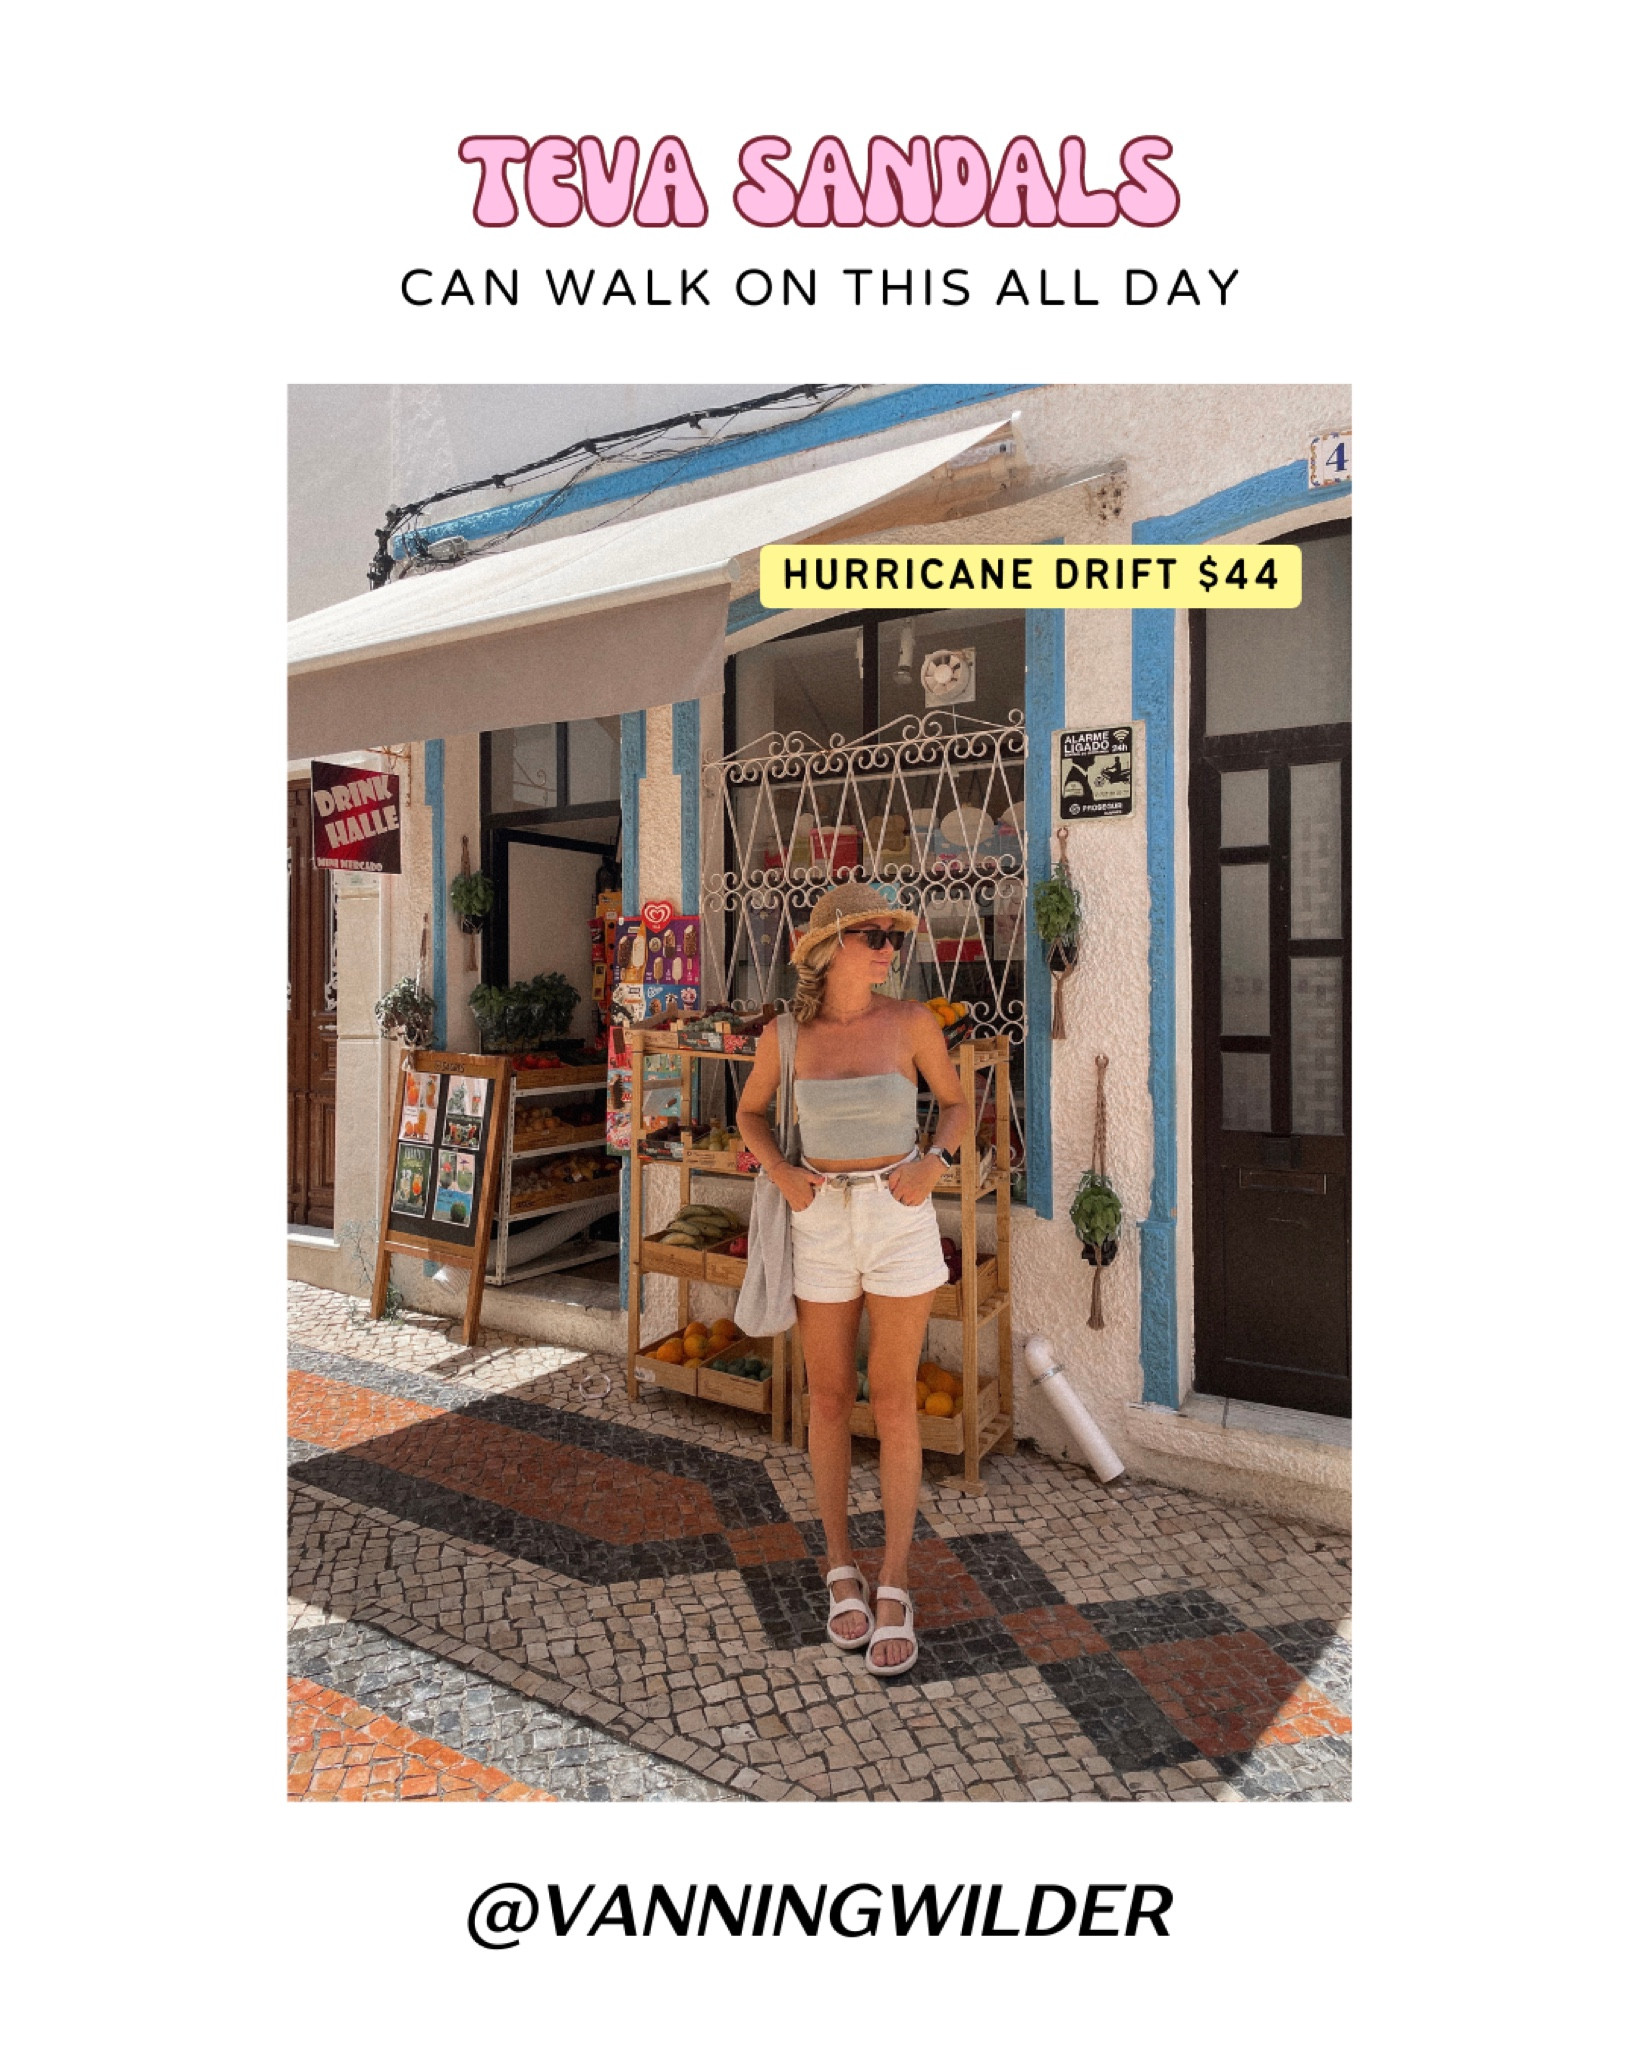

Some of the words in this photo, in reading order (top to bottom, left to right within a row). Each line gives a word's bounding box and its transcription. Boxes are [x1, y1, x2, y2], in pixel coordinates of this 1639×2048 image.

[1326, 443, 1350, 472] 4
[1064, 731, 1110, 744] ALARME
[1064, 741, 1110, 754] LIGADO
[1111, 743, 1128, 752] 24h
[314, 775, 394, 816] DRINK
[1082, 801, 1122, 812] PROSEGUR
[325, 805, 400, 849] HALLE
[317, 857, 338, 869] MINI
[339, 859, 382, 872] MERCADO
